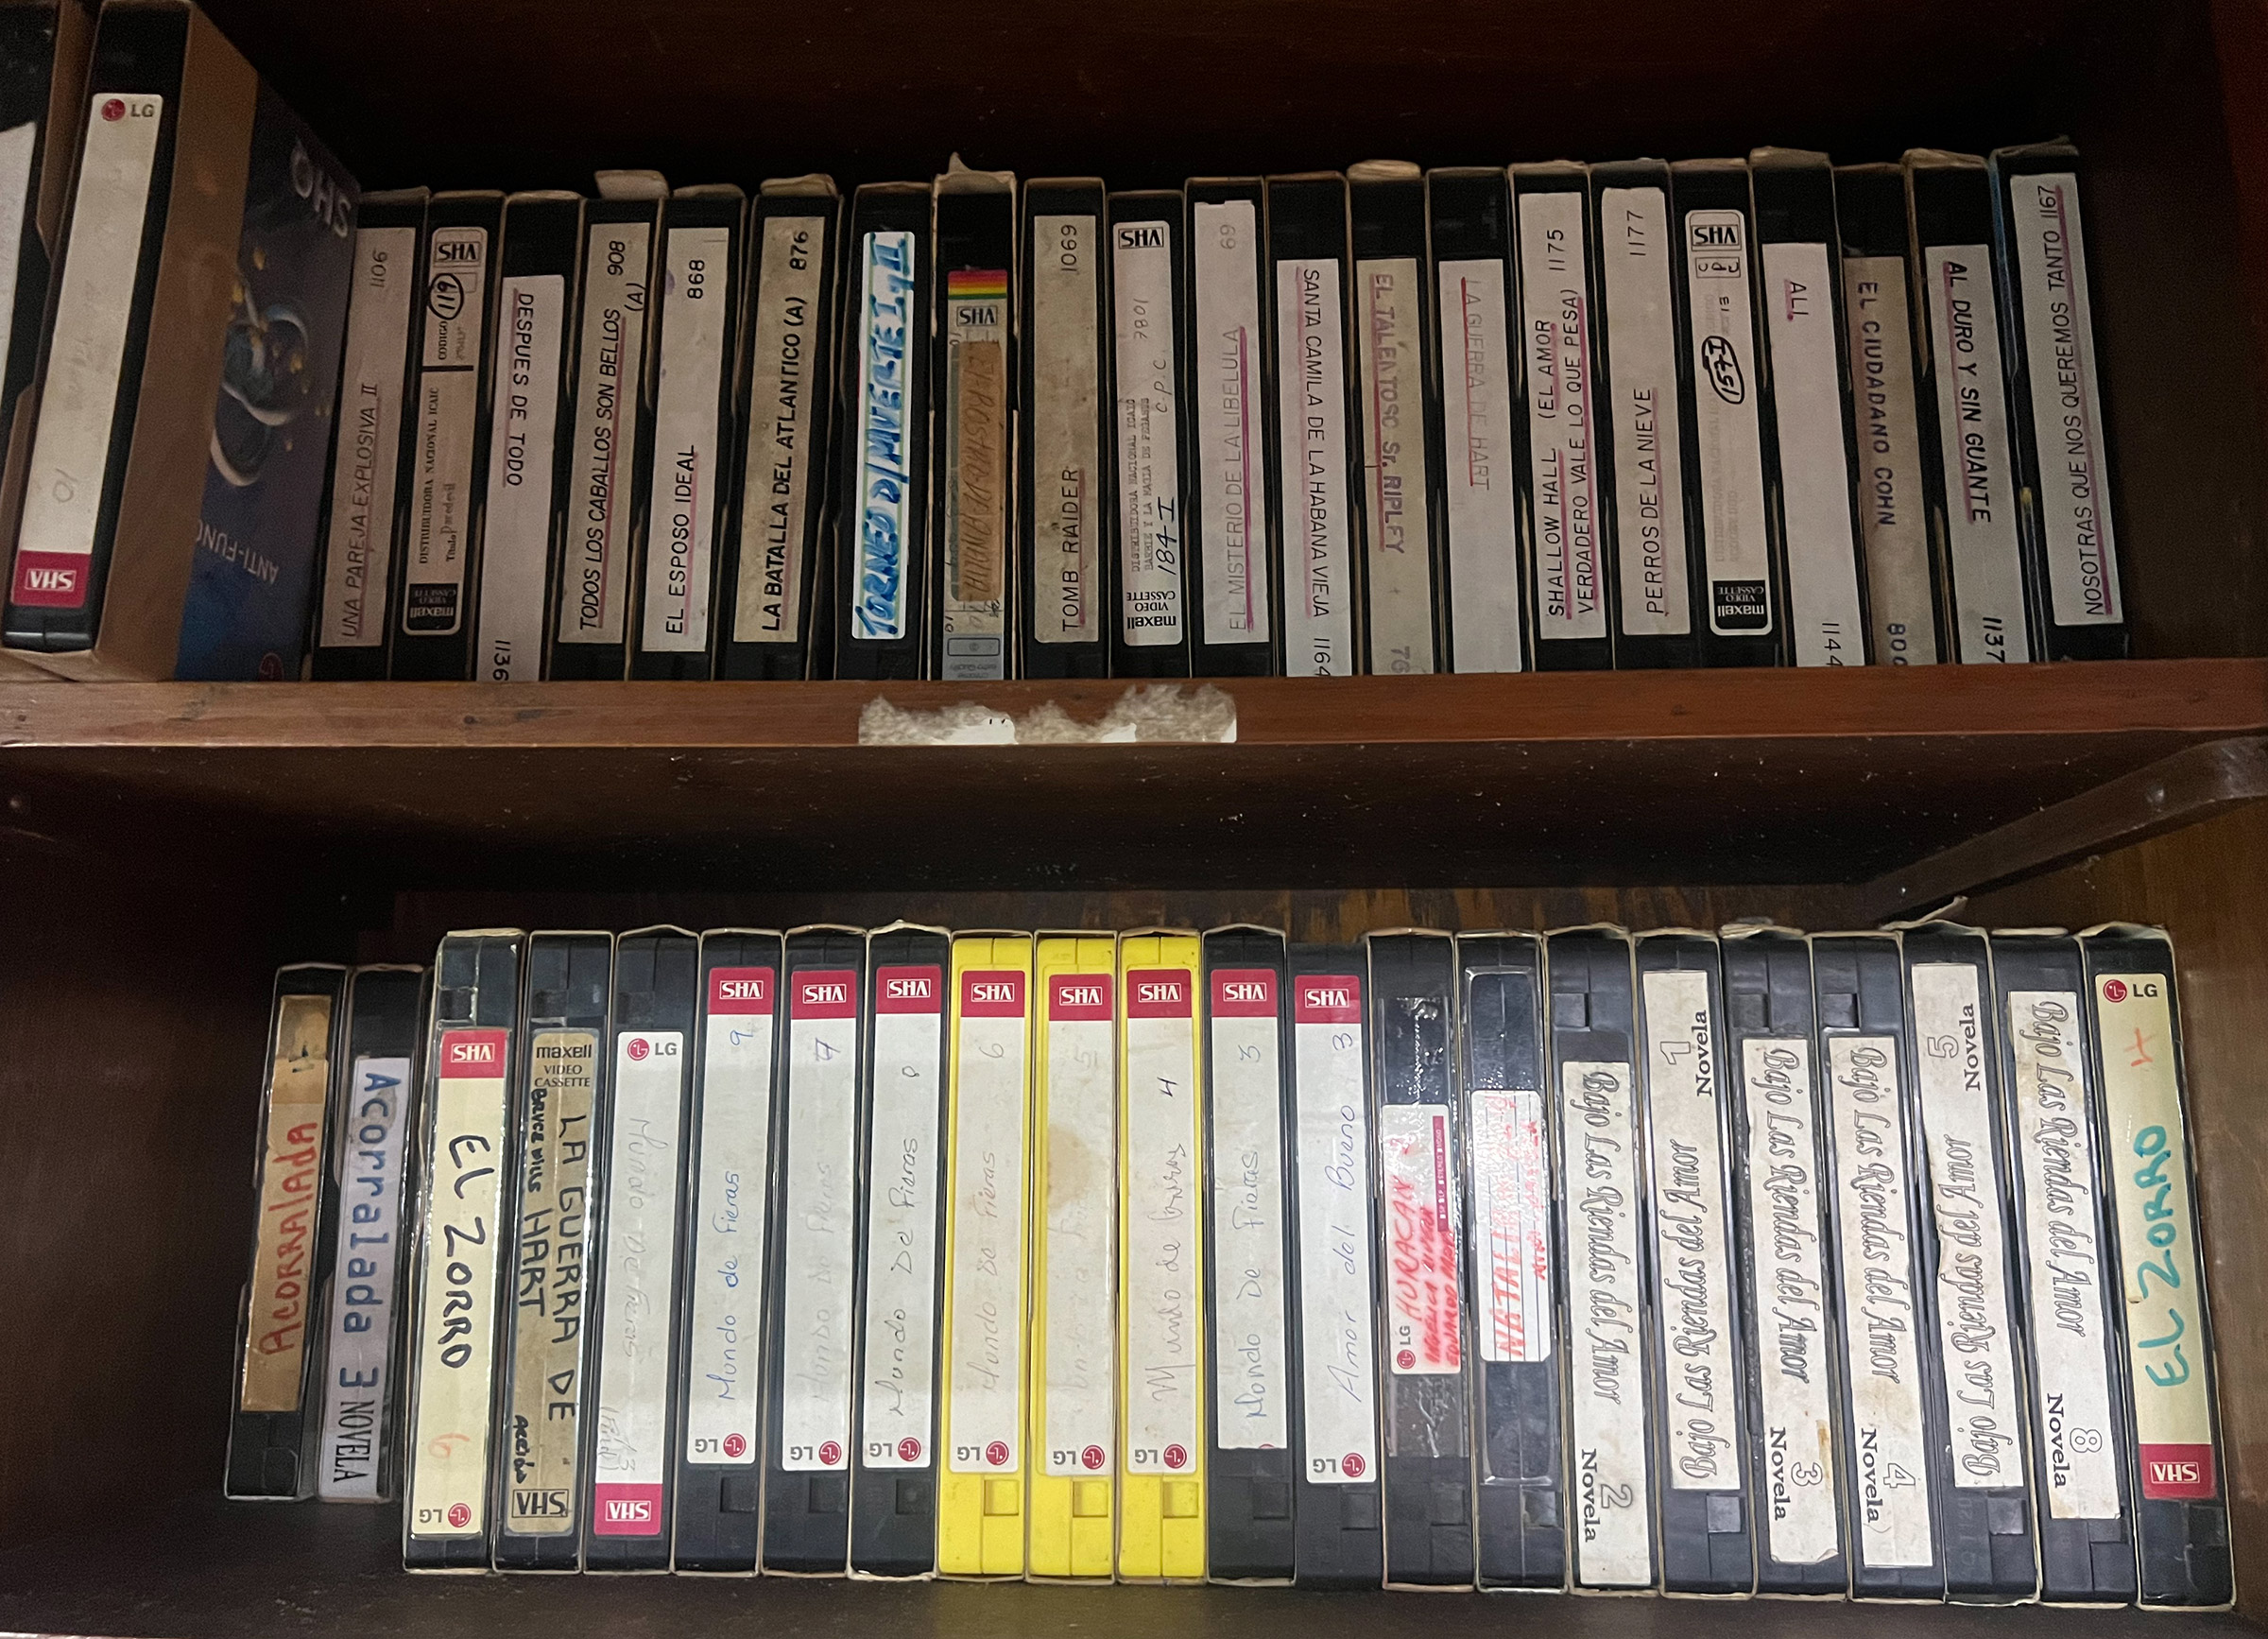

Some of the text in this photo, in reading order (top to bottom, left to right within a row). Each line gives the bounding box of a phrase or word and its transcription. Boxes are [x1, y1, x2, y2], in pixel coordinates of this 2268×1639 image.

[130, 103, 155, 118] LG
[438, 244, 476, 260] VHS
[789, 231, 810, 271] 876
[1060, 224, 1078, 273] 1069
[1121, 229, 1161, 248] VHS
[1546, 229, 1566, 271] 1175
[1626, 210, 1646, 256] 1177
[1693, 227, 1737, 245] VHS
[370, 250, 388, 287] 1106
[607, 240, 626, 276] 908
[624, 282, 646, 312] (A)
[687, 259, 706, 300] 868
[1790, 281, 1809, 317] ALI
[438, 320, 449, 360] CODIGO
[506, 293, 534, 486] DESPUES DE TODO
[1857, 282, 1897, 526] EL CIUDADANO COHN
[1947, 260, 1991, 523] AL DURO Y SIN GUANTE
[2036, 184, 2105, 615] NOSOTRAS QUE NOS QUEREMOS TANTO 1167
[352, 407, 376, 507] EXPLOSIVA
[425, 420, 438, 475] NACIONAL
[762, 296, 808, 631] LA BATALLA DEL ATLANTICO (A)
[1303, 268, 1330, 617] SANTA CAMILA DE LA HABANA VIEJA
[1559, 288, 1595, 613] VERDADERO VALE LO QUE PESA)
[579, 308, 621, 630] TODOS LOS CABALLOS SON BELLOS
[1222, 328, 1246, 630] EL MISTERIO DE LA LIBELULA
[1535, 319, 1565, 616] SHALLOW HALL (EL AMOR
[419, 478, 434, 564] DISTRIBUIDORA
[1633, 388, 1664, 613] PERROS DE LA NIEVE
[345, 515, 367, 589] PAREJA
[665, 444, 695, 634] EL ESPOSO IDEAL
[1061, 468, 1079, 631] TOMB RAIDER
[30, 571, 74, 592] VHS
[1125, 591, 1177, 601] CASSETTE
[1717, 586, 1764, 595] CASSETTE
[1725, 594, 1756, 603] VIDEO
[341, 599, 360, 638] UNA
[1126, 615, 1177, 630] maxell
[1134, 602, 1169, 612] VIDEO
[1717, 604, 1765, 617] maxell
[492, 639, 511, 681] 1136
[1982, 616, 2005, 664] 1137
[888, 980, 929, 997] VHS
[1061, 988, 1102, 1005] VHS
[2132, 983, 2158, 998] LG
[452, 1045, 492, 1061] VHS
[536, 1044, 593, 1059] maxell
[1332, 1032, 1353, 1051] 3
[1659, 1041, 1692, 1065] 1
[1691, 1009, 1713, 1097] Novela
[534, 1077, 591, 1088] CASSETTE
[543, 1064, 583, 1075] VIDEO
[2019, 1000, 2096, 1338] Bajo Las Riendas del Amor
[338, 1072, 402, 1388] Acorralada 3
[1571, 1071, 1633, 1406] Bajo Las Riendas del Amor
[519, 1207, 555, 1318] HART
[547, 1114, 587, 1421] LA GUERRA DE
[1324, 1104, 1362, 1403] Amor del Bueno
[2132, 1125, 2191, 1387] EL ZORRO
[438, 1216, 487, 1369] ZORRO
[1659, 1138, 1731, 1479] Bajo Las Riendas del Amor
[333, 1400, 375, 1483] NOVELA
[1053, 1450, 1076, 1465] LG
[2046, 1392, 2070, 1489] Novela
[2069, 1427, 2104, 1454] 8
[2153, 1463, 2198, 1482] VHS
[516, 1492, 566, 1515] VHS
[608, 1501, 649, 1520] VHS
[1581, 1448, 1601, 1544] Novela
[1600, 1483, 1634, 1510] 2
